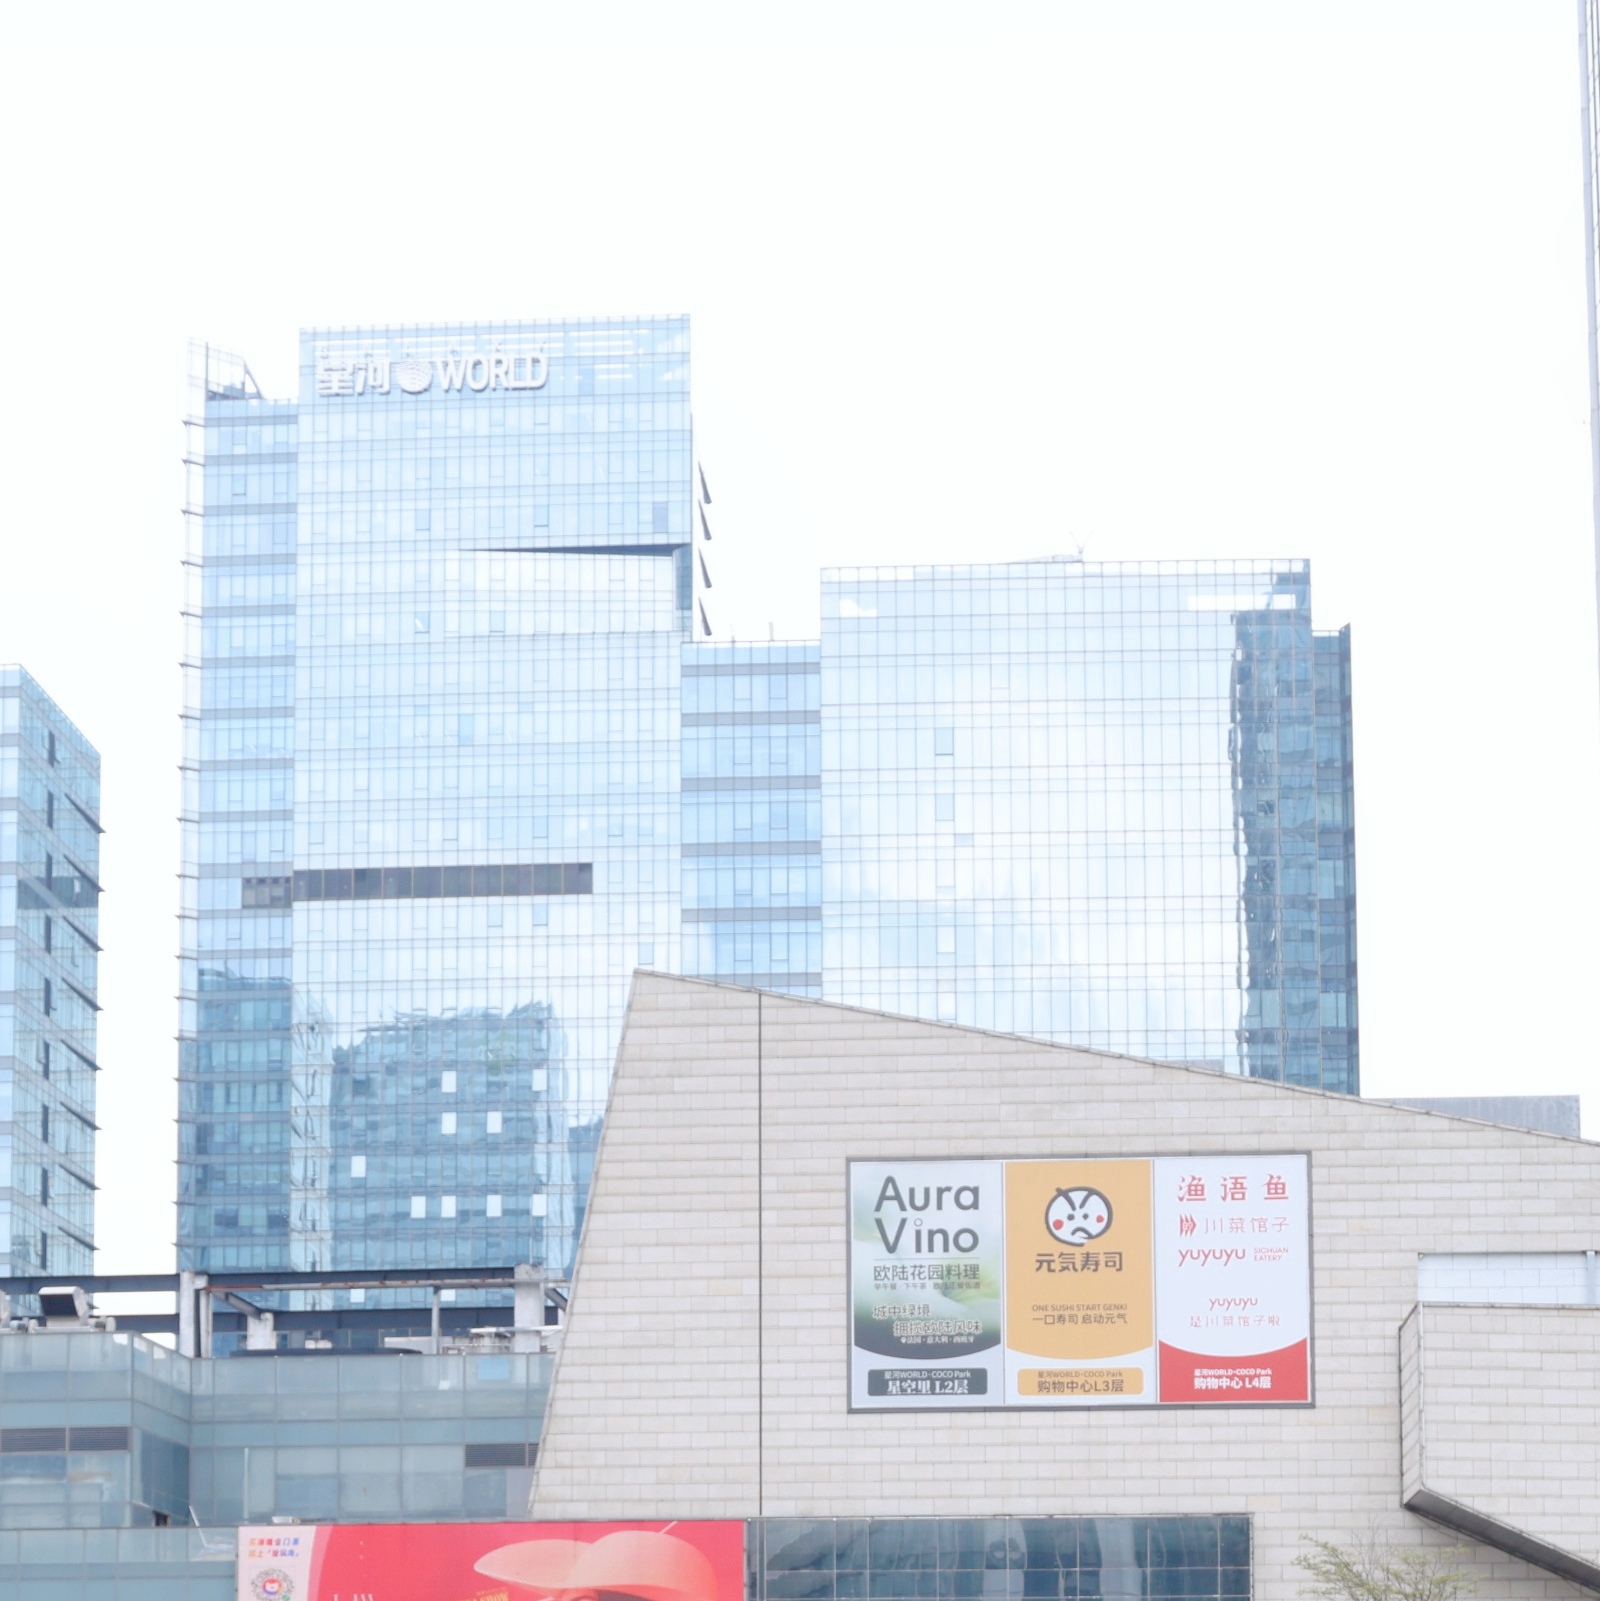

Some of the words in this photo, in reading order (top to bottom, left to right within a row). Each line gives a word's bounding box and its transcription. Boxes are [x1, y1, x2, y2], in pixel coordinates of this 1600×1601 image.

[435, 352, 550, 393] WORLD
[874, 1175, 980, 1213] Aura
[1178, 1173, 1289, 1202] 渔语鱼
[874, 1217, 980, 1254] Vino
[1035, 1251, 1124, 1274] 元気寿司
[1178, 1248, 1246, 1267] yuyuyu
[873, 1263, 980, 1281] 欧陆花园料理
[873, 1303, 931, 1318] 城中绿境
[1032, 1304, 1049, 1312] ONE
[1051, 1304, 1075, 1312] SUSHI
[1103, 1303, 1128, 1311] GENKI
[1209, 1297, 1258, 1311] yuyuyu
[1081, 1313, 1128, 1324] 启动元气
[954, 1370, 972, 1379] Park
[887, 1379, 931, 1395] 星空里
[934, 1379, 969, 1394] L2层
[1037, 1379, 1124, 1393] 购物中心L3层
[1194, 1377, 1242, 1390] 购物中心
[1245, 1376, 1272, 1389] L4层
